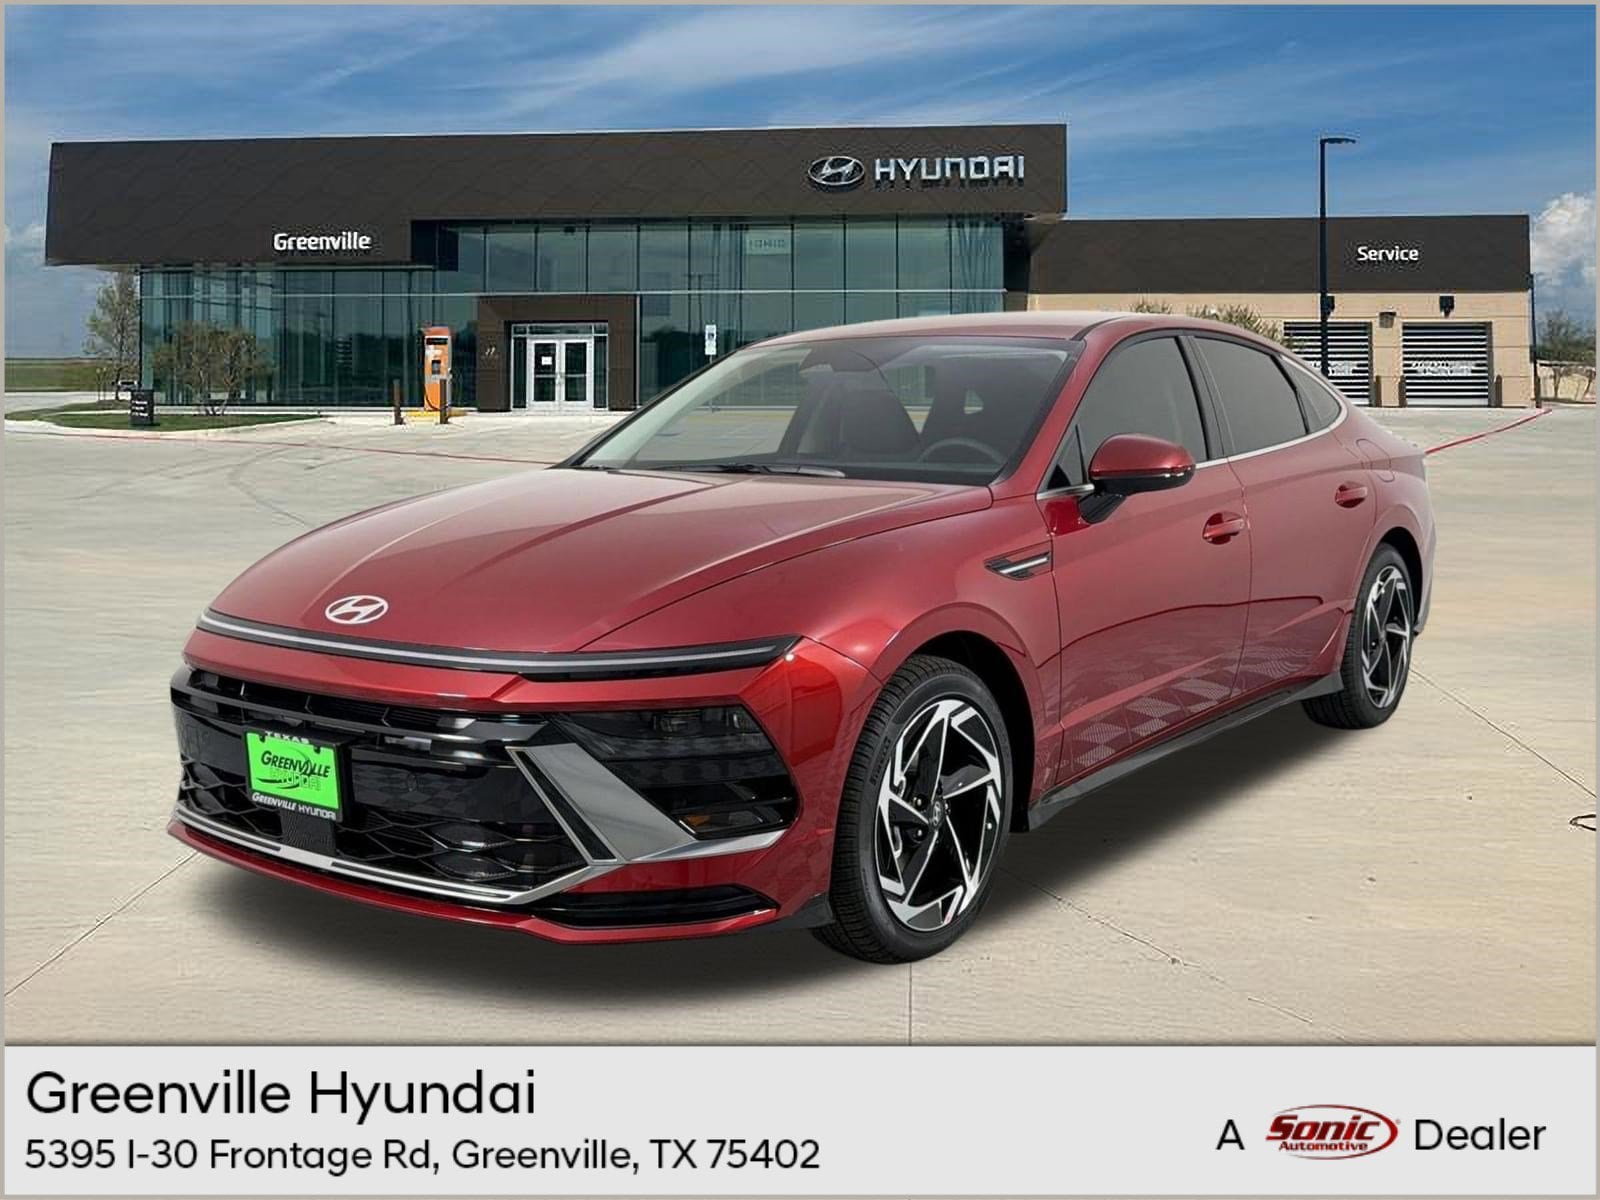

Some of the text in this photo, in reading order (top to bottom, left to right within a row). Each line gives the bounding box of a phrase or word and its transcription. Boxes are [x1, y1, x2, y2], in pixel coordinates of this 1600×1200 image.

[874, 156, 1025, 181] HYUNDAI
[273, 231, 372, 251] Greenville
[1357, 245, 1419, 261] Service
[261, 750, 331, 778] GREENVILLE
[252, 792, 337, 821] GREENVILLE HYUNDAI
